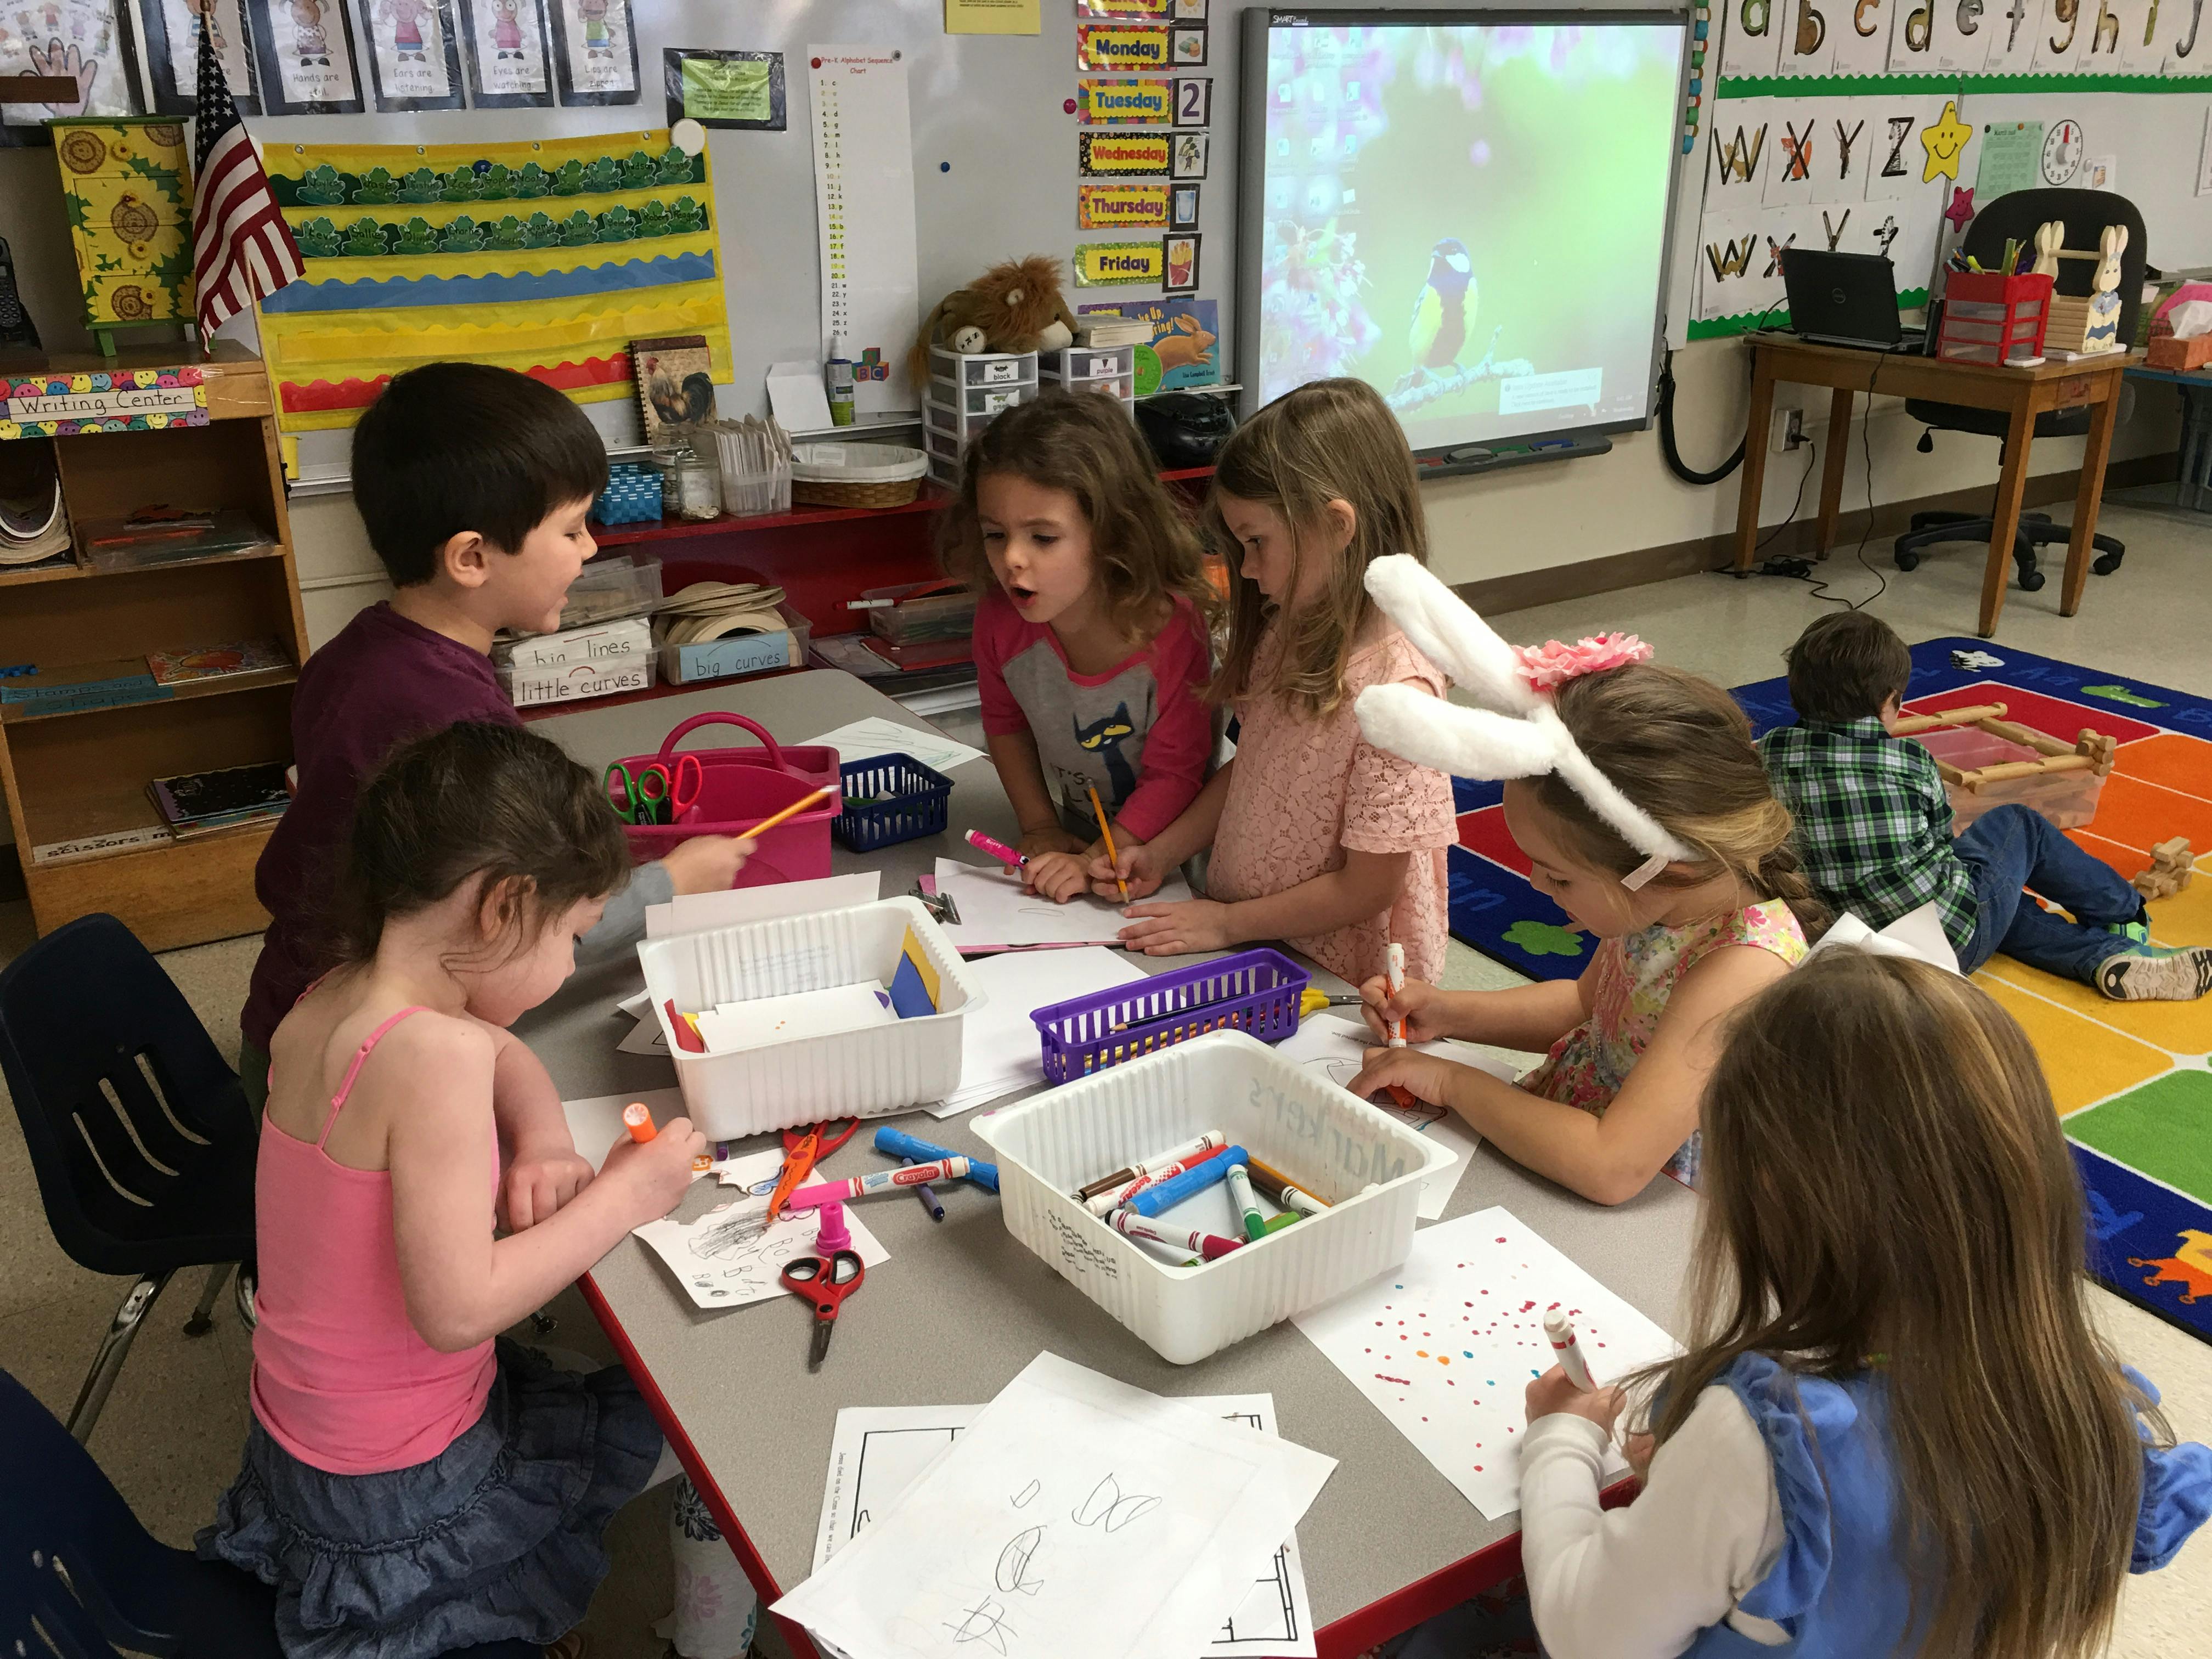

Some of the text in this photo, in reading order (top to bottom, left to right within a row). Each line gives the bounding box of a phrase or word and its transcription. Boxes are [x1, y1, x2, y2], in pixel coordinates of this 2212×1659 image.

[1273, 14, 1294, 23] SMART
[1096, 39, 1160, 59] Monday
[293, 72, 339, 82] Hands are
[394, 68, 432, 78] Ears are
[493, 65, 530, 76] Eyes are
[603, 65, 618, 73] are
[493, 80, 534, 91] watching.
[1095, 92, 1162, 111] Tuesday
[1182, 83, 1200, 117] 2
[1093, 145, 1166, 162] Wednesday
[1714, 122, 1768, 185] W
[1781, 119, 1815, 183] X
[1836, 119, 1864, 180] Y
[1881, 117, 1915, 178] Z
[450, 178, 472, 189] Zoe
[1093, 198, 1164, 217] Thursday
[1099, 255, 1150, 273] Friday
[865, 353, 874, 362] A
[859, 368, 881, 380] B C
[993, 372, 1011, 381] black
[1096, 366, 1114, 375] purple
[19, 390, 183, 416] Writing Center
[587, 639, 631, 655] lines
[695, 652, 781, 676] big curves
[12, 679, 143, 699] Stamps and
[522, 673, 641, 703] little curves
[46, 836, 140, 859] scissors
[985, 838, 1003, 850] Berry
[1342, 1034, 1359, 1043] dotted
[896, 1169, 935, 1182] Crayola
[832, 1496, 840, 1510] Cross
